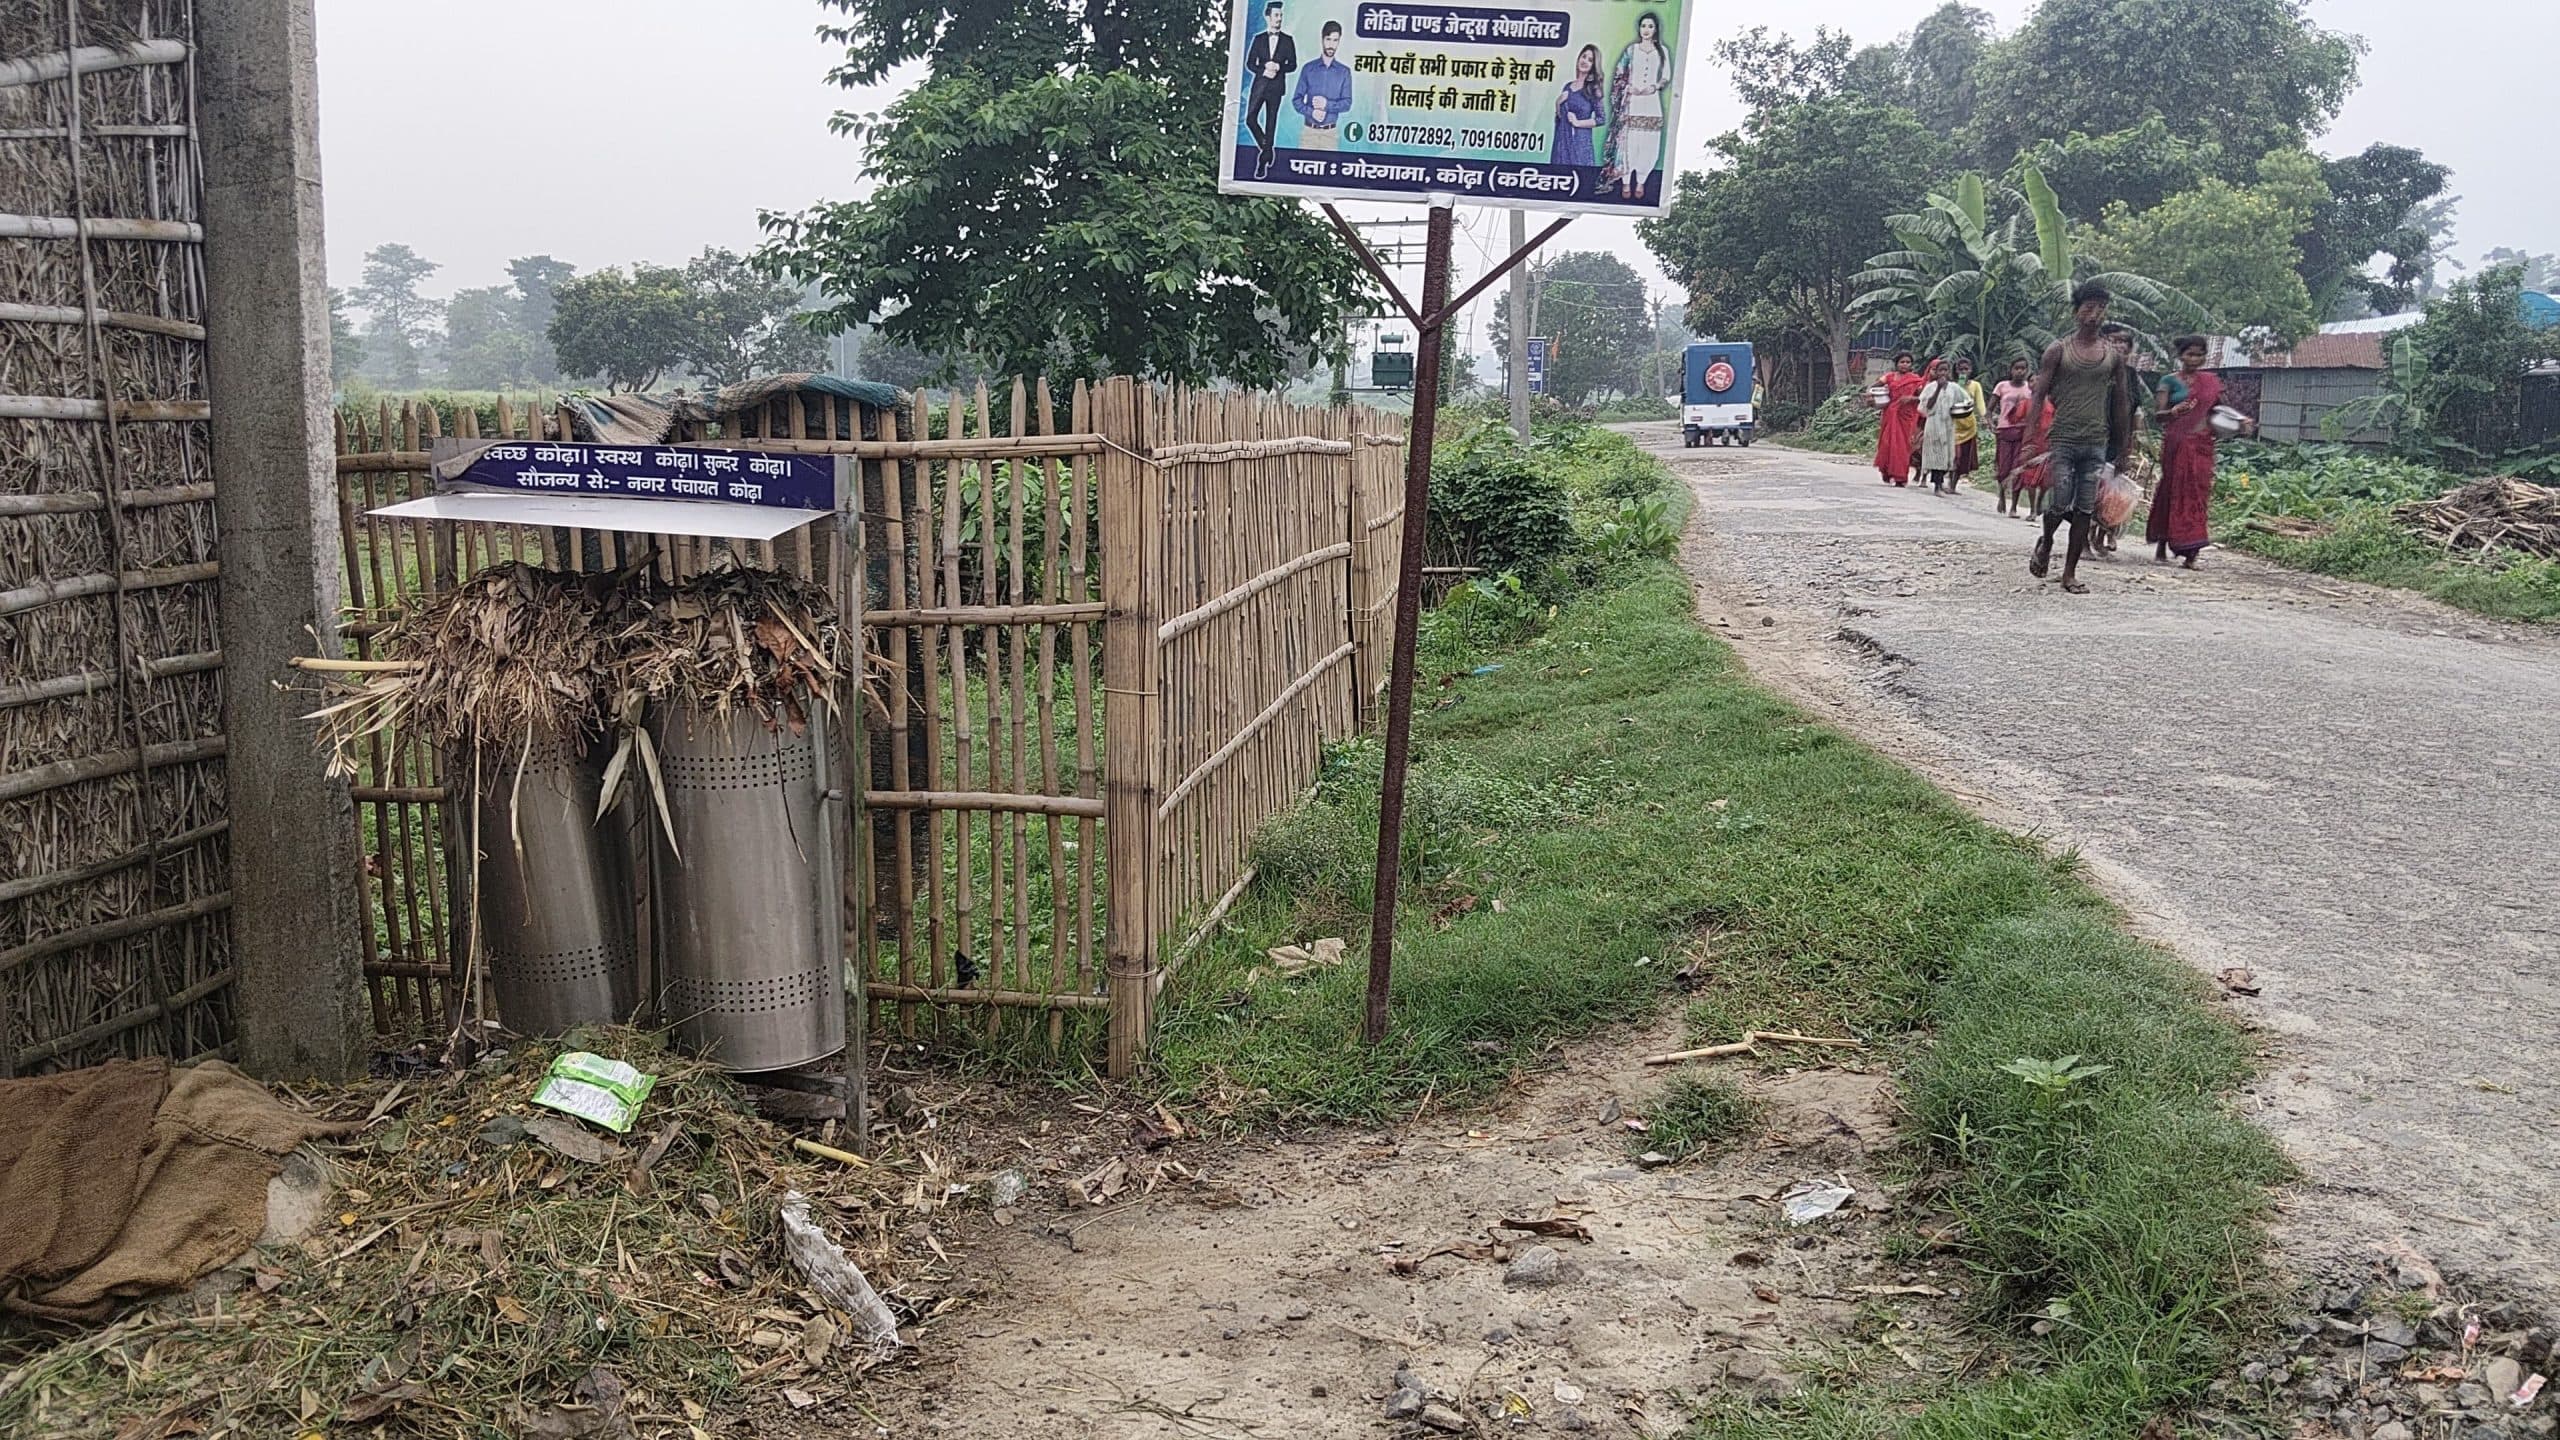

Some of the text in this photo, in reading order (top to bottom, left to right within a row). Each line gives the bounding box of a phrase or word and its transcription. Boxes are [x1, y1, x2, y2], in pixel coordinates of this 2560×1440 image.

[1364, 9, 1408, 31] लेडिज
[1411, 15, 1443, 34] एण्ड
[1492, 15, 1561, 39] स्पेशलिस्ट
[1354, 51, 1555, 85] हमारे यहाँ सभी प्रकार के ड्रेस की
[1390, 84, 1435, 110] सिलाई
[1439, 86, 1458, 109] की
[1462, 89, 1496, 111] जाती
[1368, 124, 1545, 151] 8377072892, 7091608701
[1290, 159, 1327, 175] पता
[1341, 158, 1431, 184] गोरगामा,
[1436, 164, 1484, 189] कोढ़ा
[1488, 166, 1580, 197] (कटिहार)
[595, 449, 642, 466] स्वस्थ
[516, 466, 580, 488] सौजन्य
[627, 476, 666, 492] नगर
[671, 474, 718, 496] पंचायत
[729, 478, 762, 504] कोढ़ा
